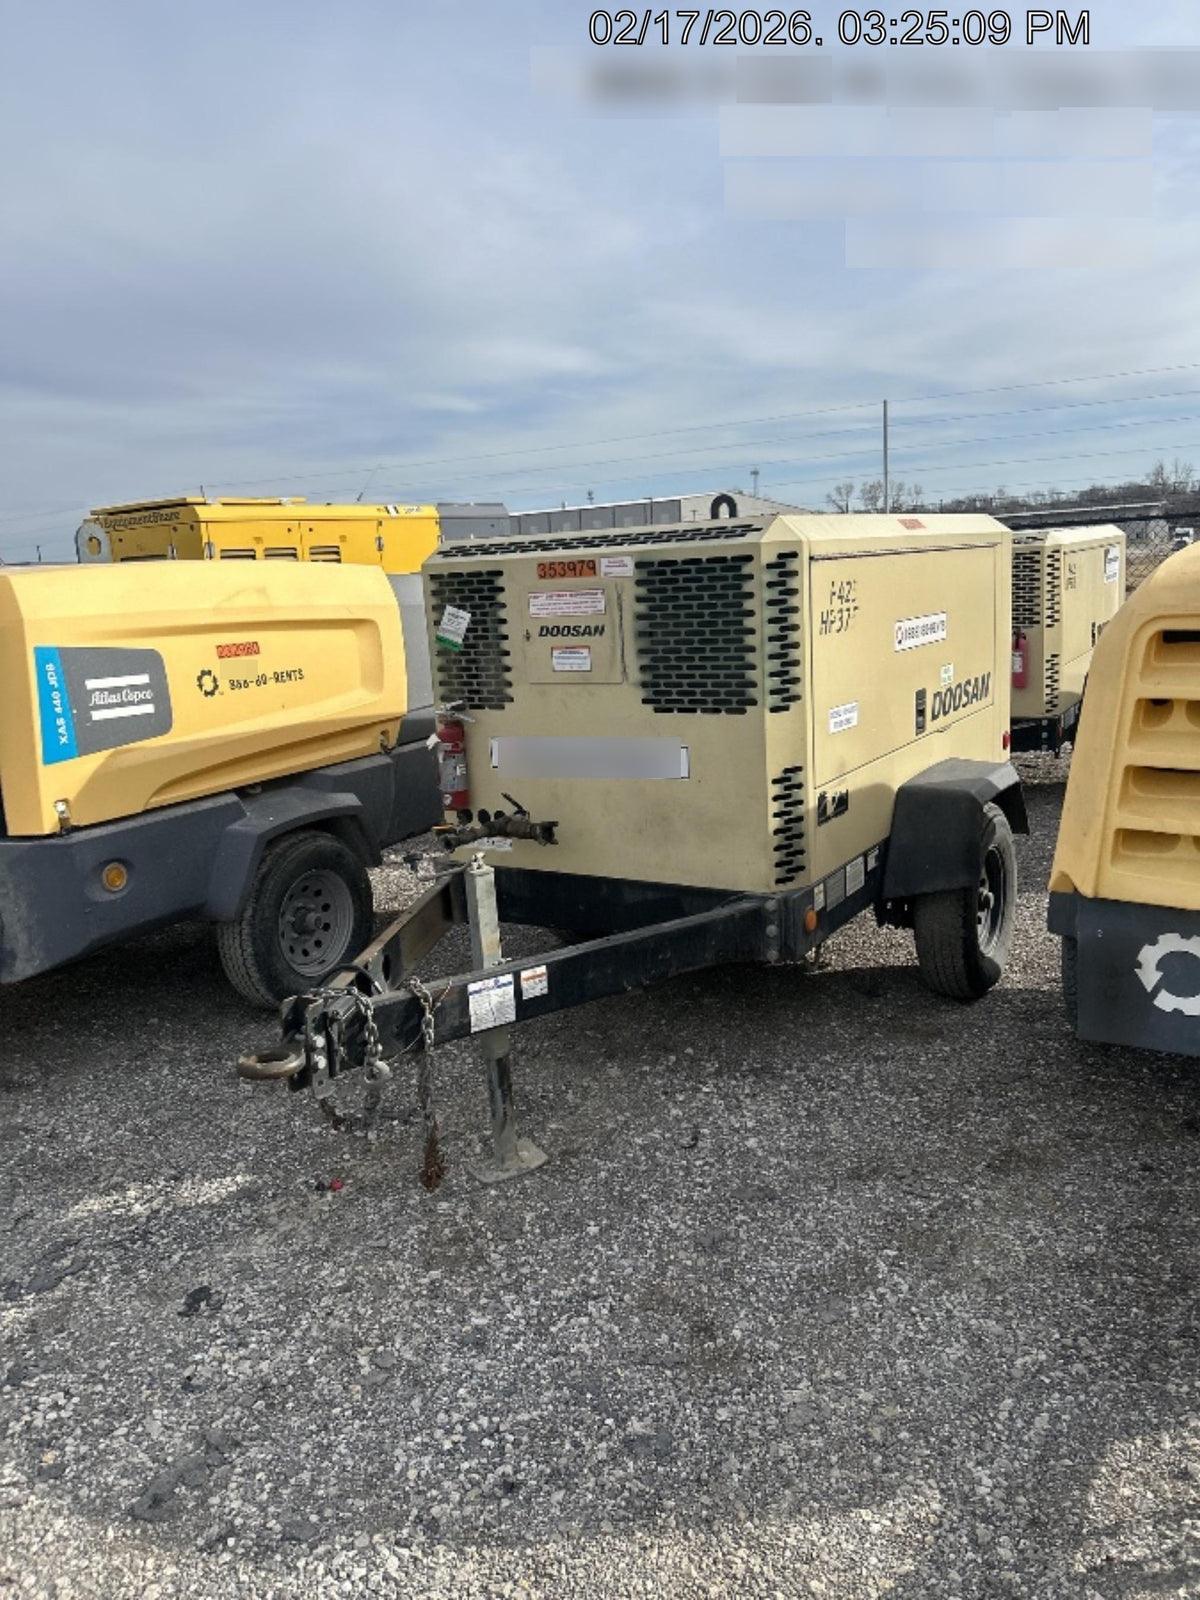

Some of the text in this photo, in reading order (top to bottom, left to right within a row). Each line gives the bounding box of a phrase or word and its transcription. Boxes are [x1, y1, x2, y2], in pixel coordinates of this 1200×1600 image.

[537, 559, 597, 579] 353979
[538, 624, 605, 637] DOOSAN
[51, 691, 63, 714] 440
[88, 688, 153, 706] Atlas Copco
[931, 671, 991, 722] DOOSAN
[56, 717, 69, 746] XAS
